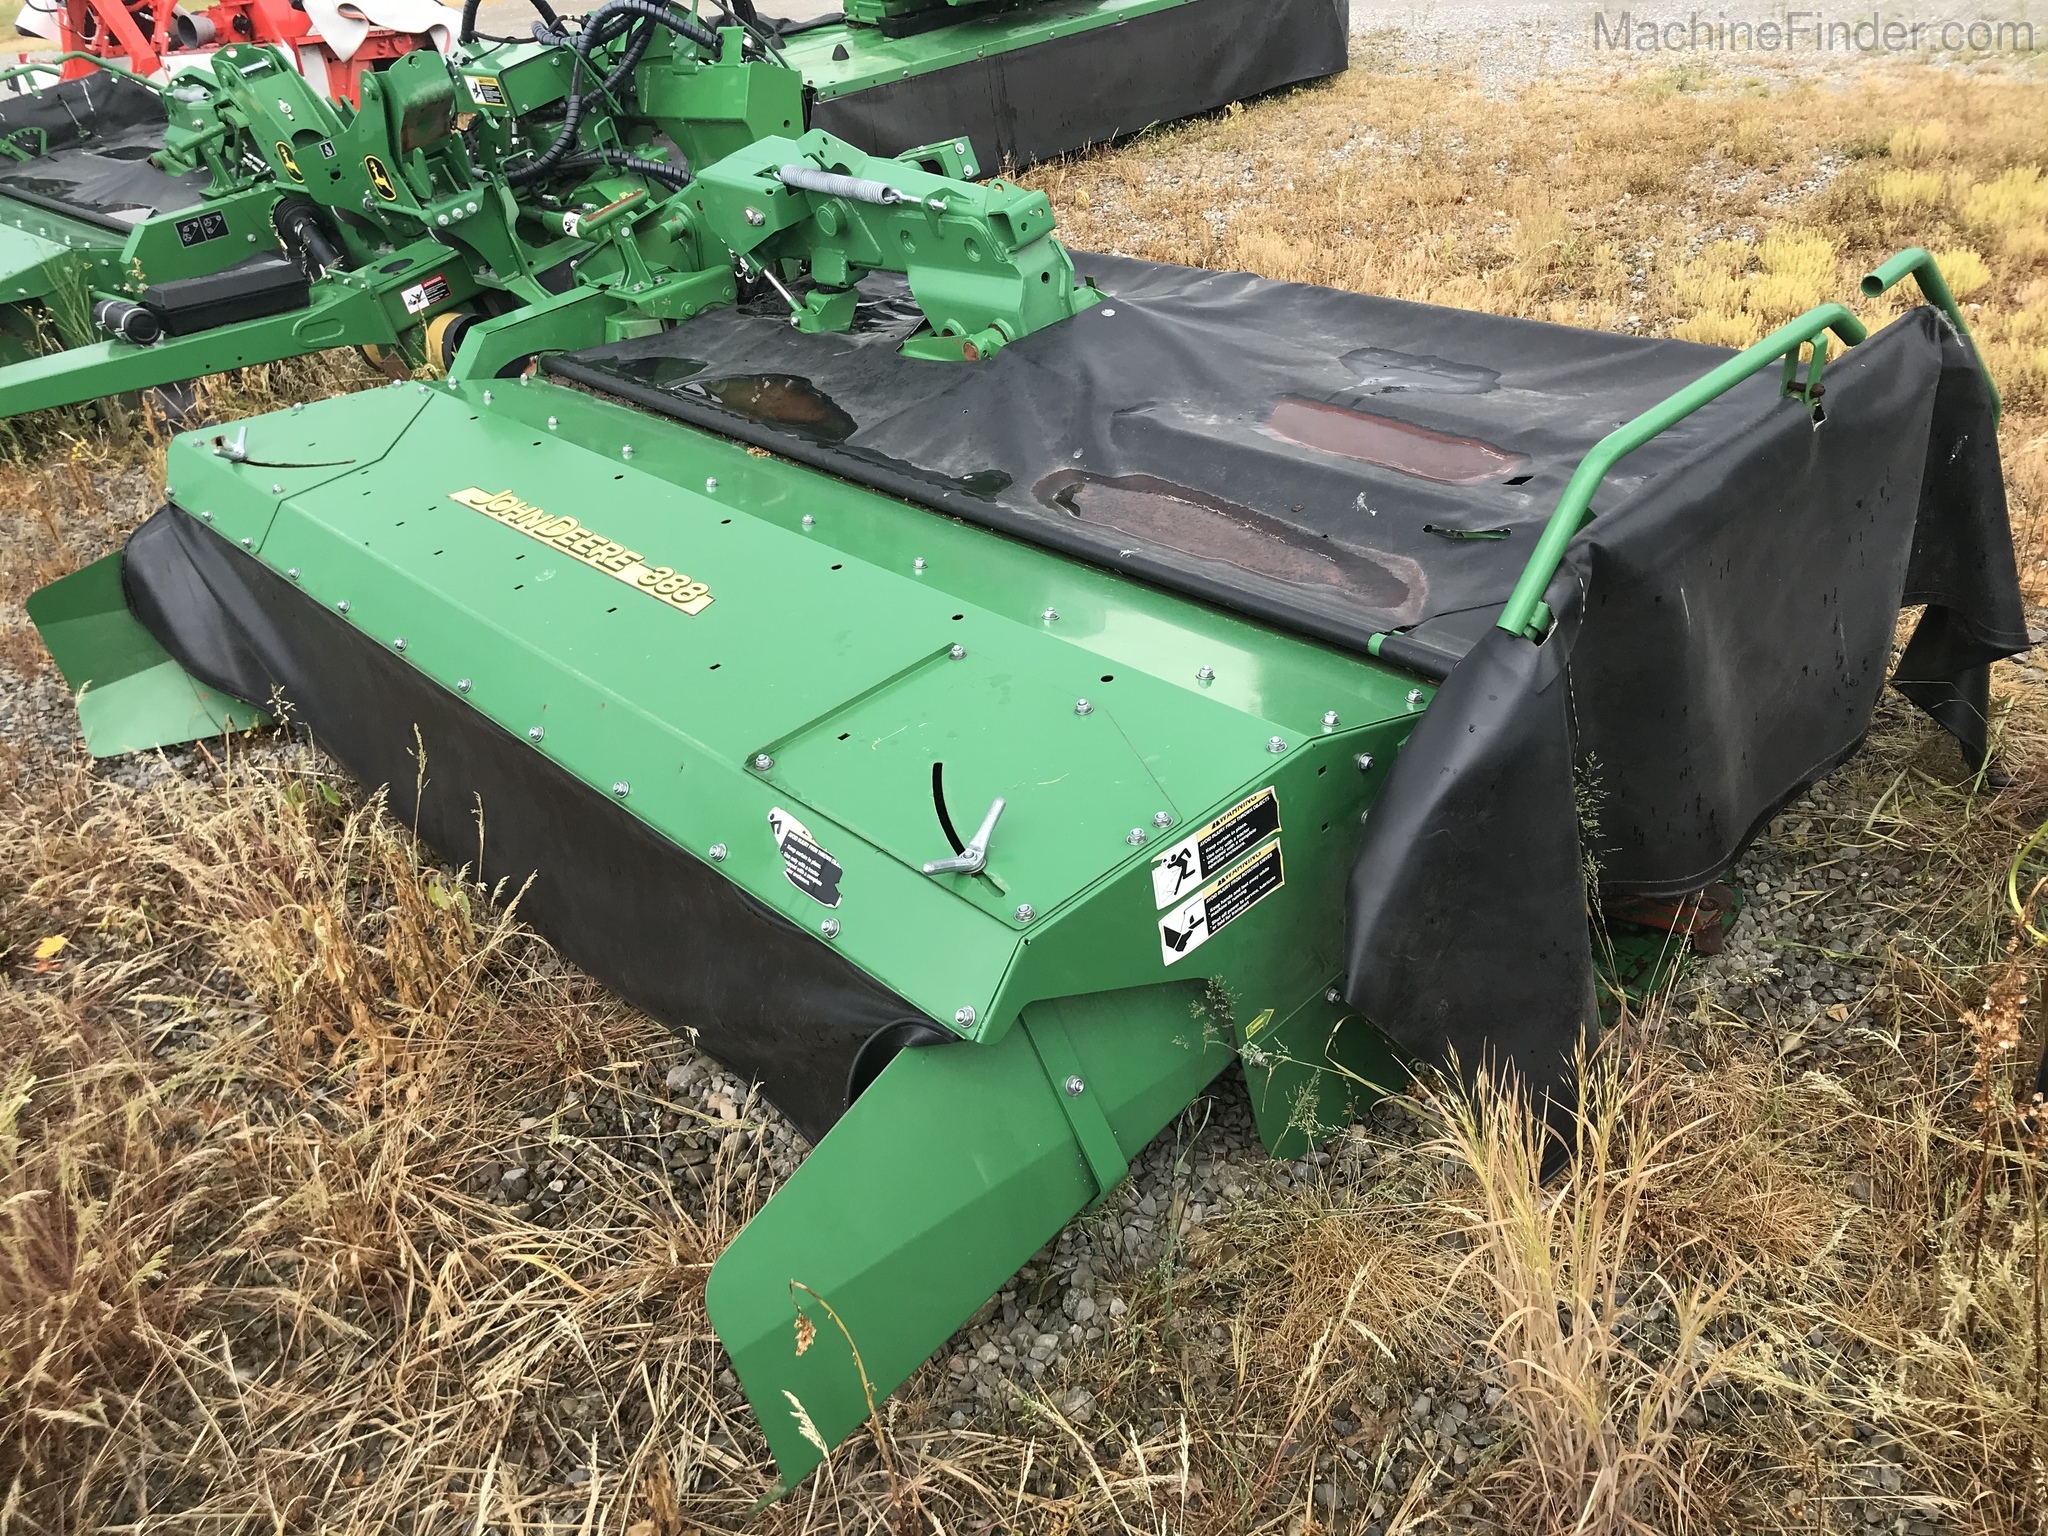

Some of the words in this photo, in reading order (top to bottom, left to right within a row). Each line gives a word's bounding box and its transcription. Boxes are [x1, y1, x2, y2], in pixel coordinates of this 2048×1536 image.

[533, 515, 646, 572] DEERE
[637, 566, 709, 603] 388
[1200, 836, 1211, 846] AVOID
[1212, 827, 1224, 838] INJURY
[1226, 819, 1236, 829] FROM
[1253, 796, 1269, 810] OBJECTS
[1237, 828, 1250, 838] tractor
[1239, 828, 1256, 842] complete
[1206, 844, 1216, 852] Keep
[1217, 834, 1230, 845] curtain
[1206, 893, 1217, 903] AVOID
[1218, 883, 1230, 895] INJURY
[1231, 875, 1241, 885] FROM
[1260, 853, 1272, 864] KNIVES
[1210, 903, 1220, 912] Keep
[1220, 894, 1232, 904] hands
[1249, 875, 1258, 884] away
[1259, 867, 1269, 876] while
[1212, 916, 1221, 925] Shut
[1228, 903, 1239, 914] power
